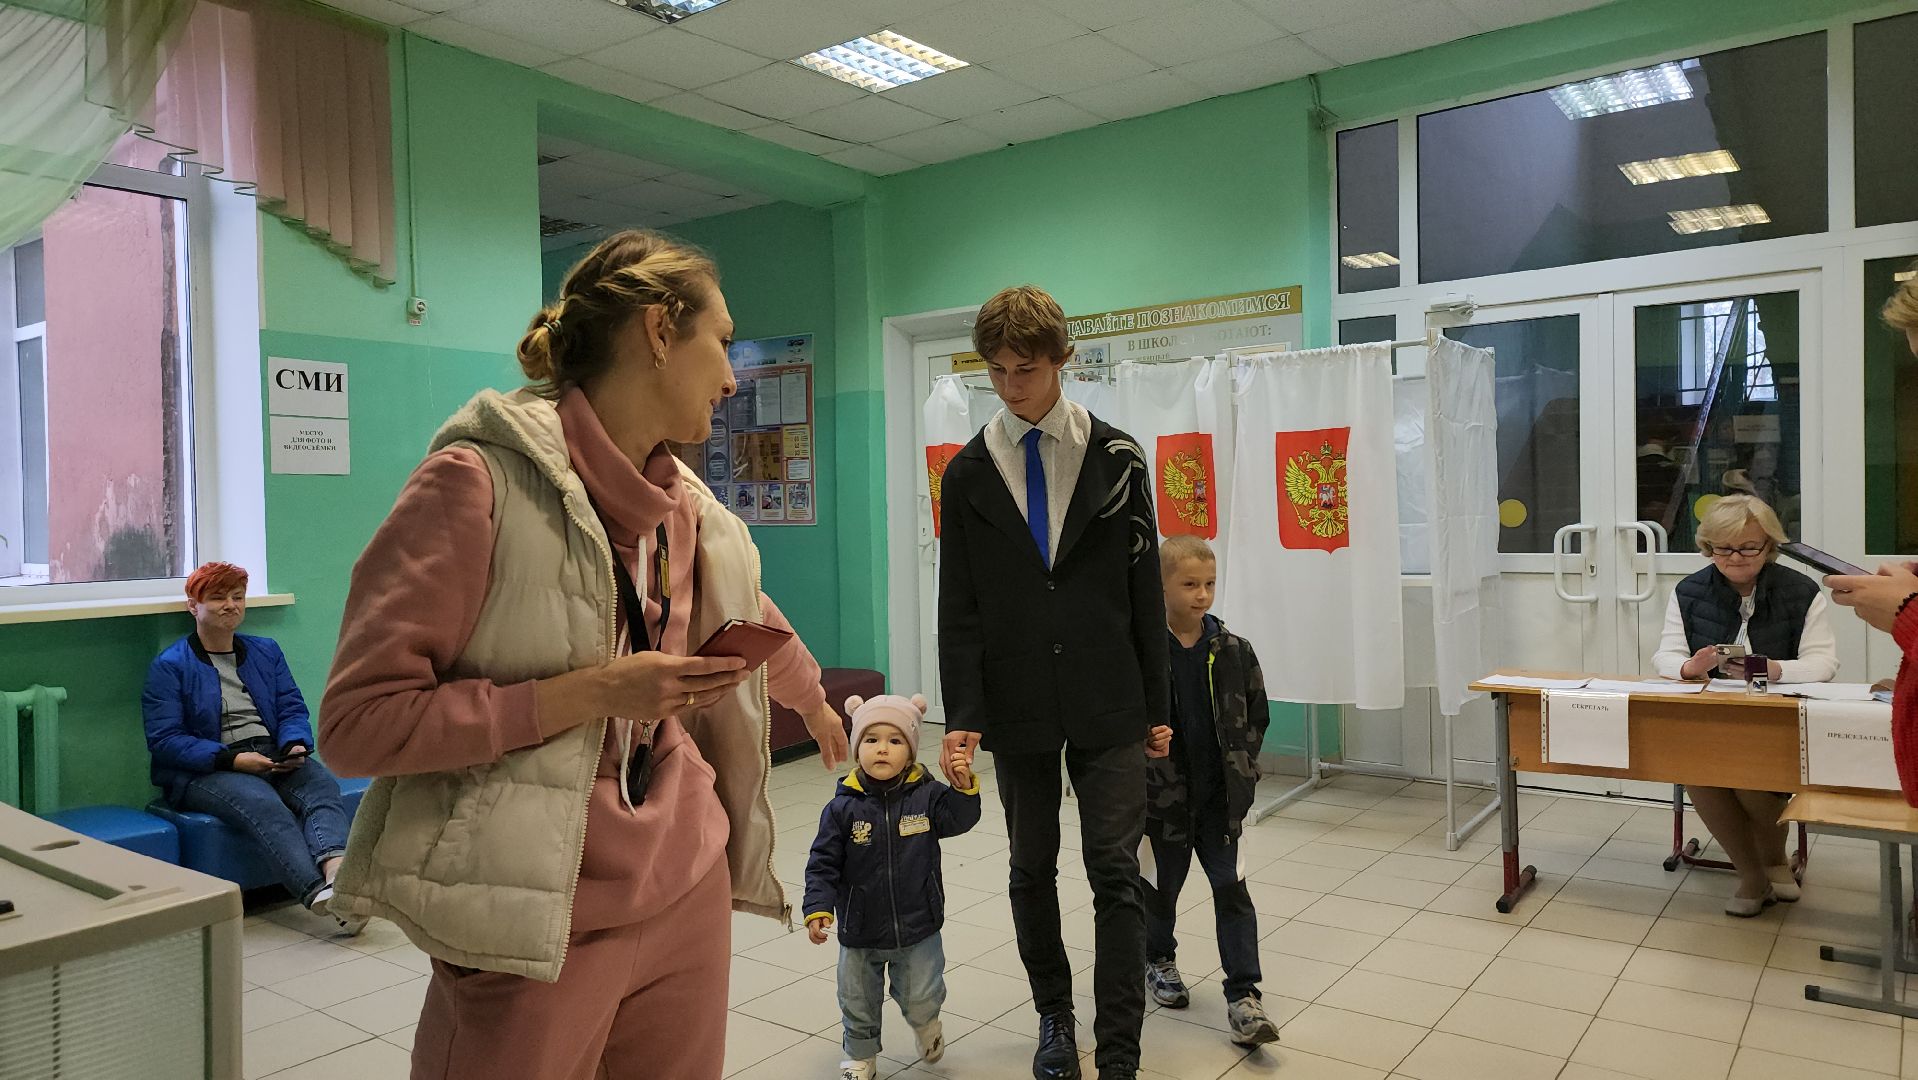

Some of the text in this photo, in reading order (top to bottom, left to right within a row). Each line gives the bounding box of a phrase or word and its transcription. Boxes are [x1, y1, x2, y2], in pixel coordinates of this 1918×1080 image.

[1137, 292, 1290, 328] ПОЗНАКОМИМСЯ
[1128, 340, 1135, 351] В
[275, 368, 345, 393] СМИ
[1827, 732, 1889, 741] ПРЕДСЕДАТЕЛЬ
